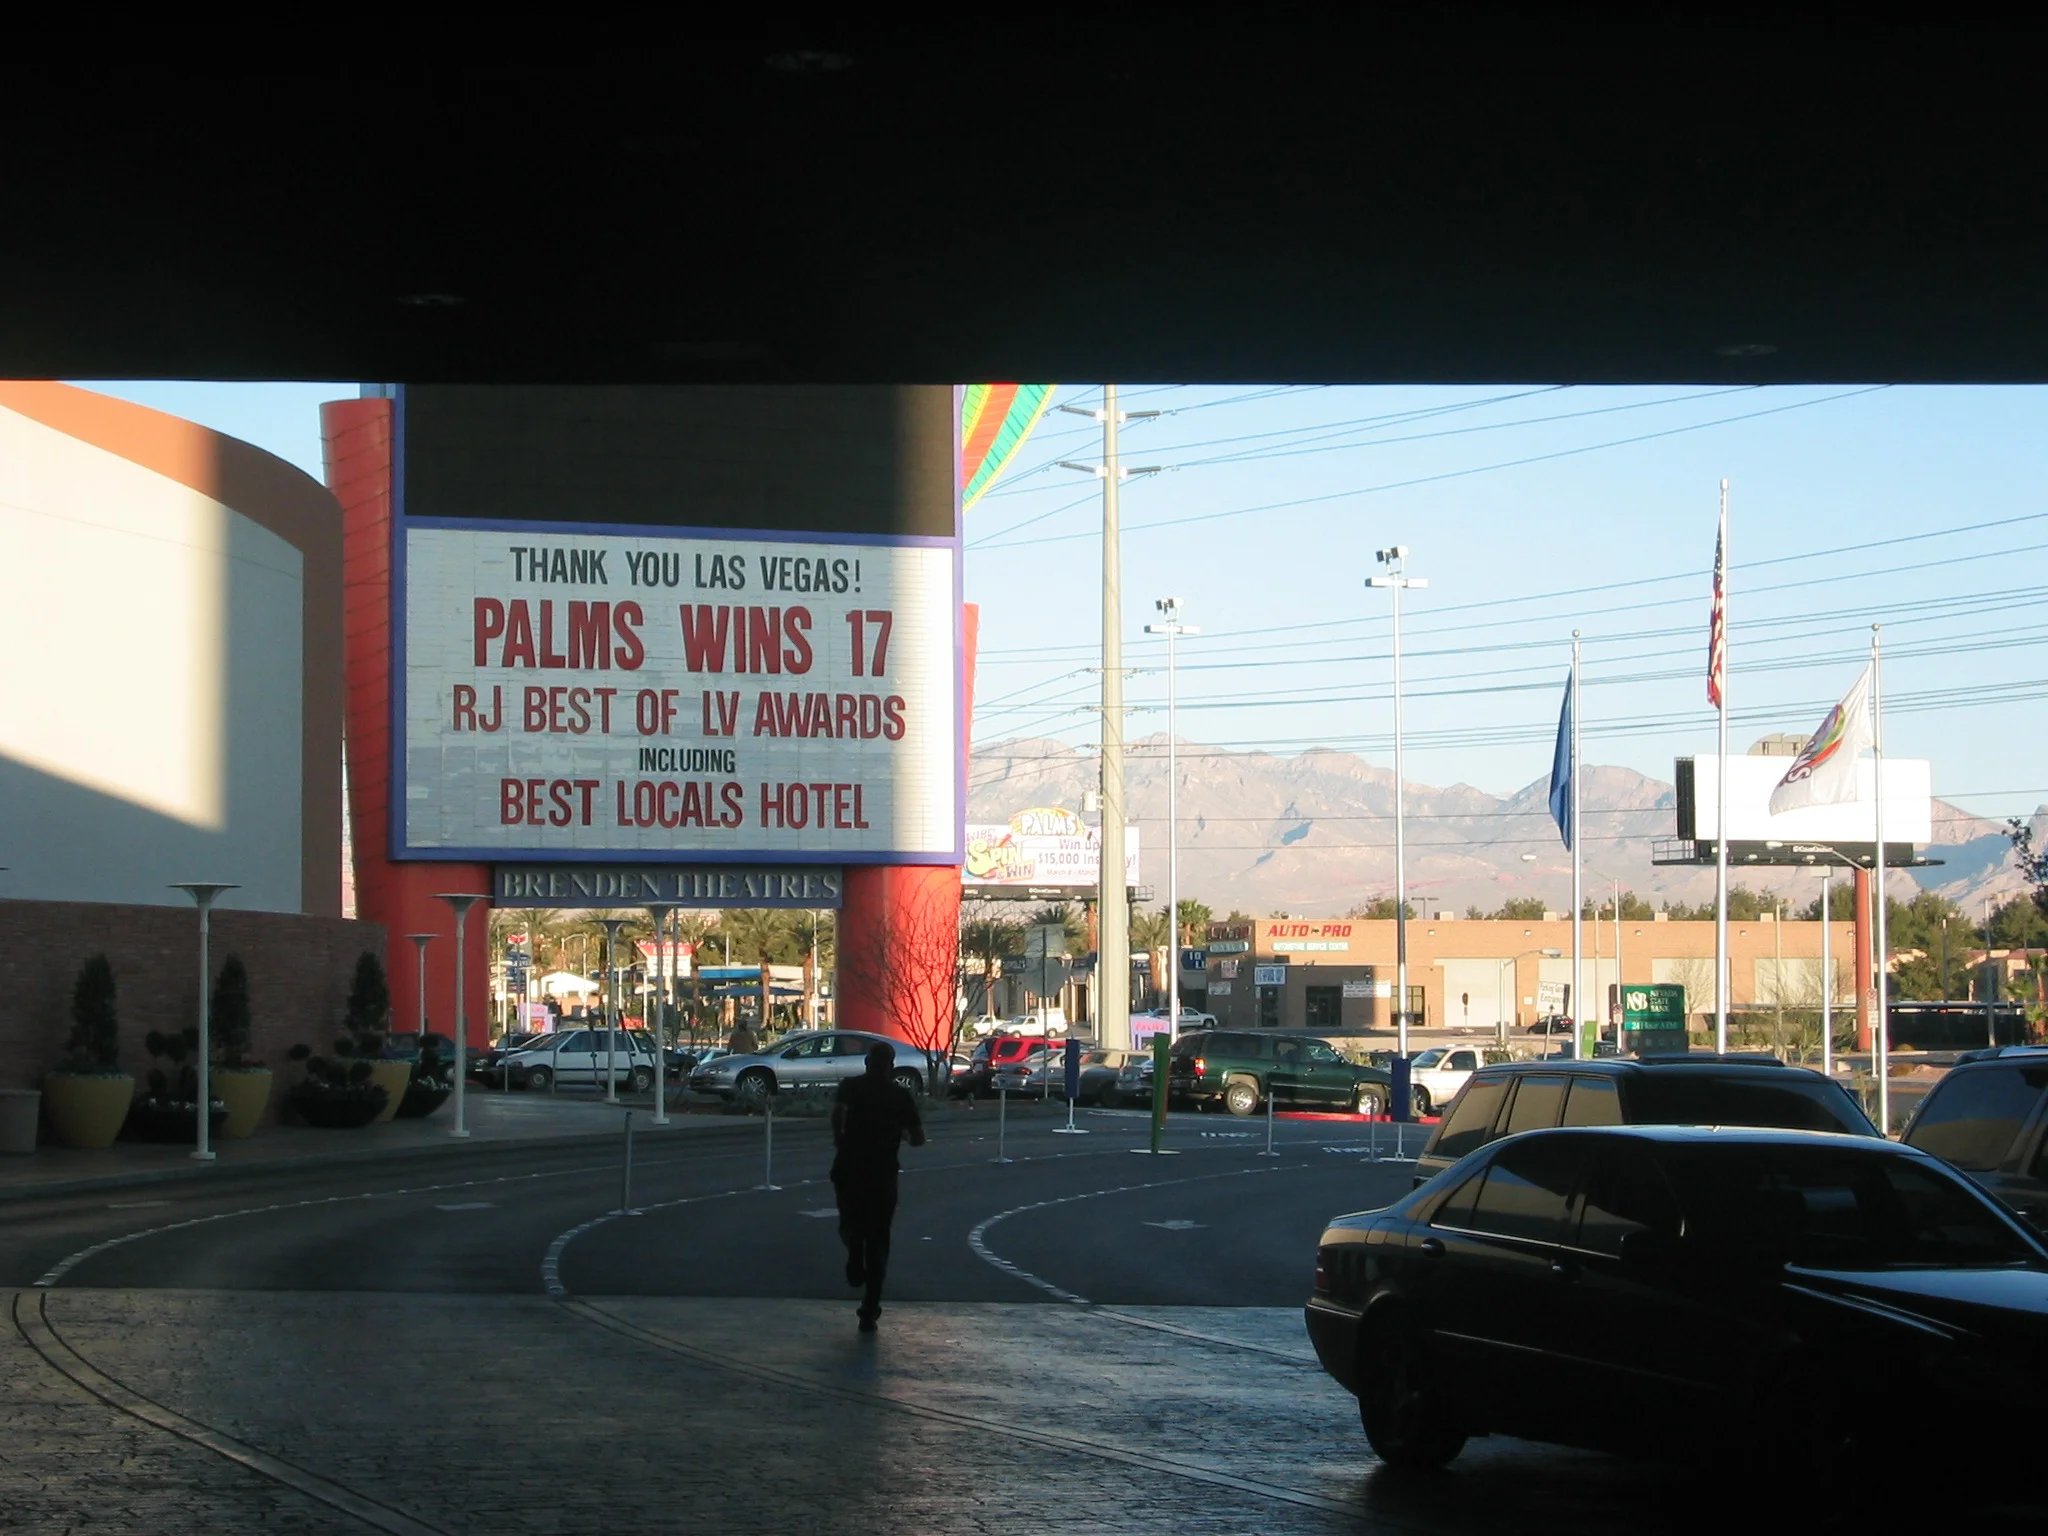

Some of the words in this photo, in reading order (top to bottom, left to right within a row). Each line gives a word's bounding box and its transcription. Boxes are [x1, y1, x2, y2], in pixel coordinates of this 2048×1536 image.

[509, 547, 608, 586] THANK
[625, 551, 679, 588] YOU
[695, 553, 746, 590] LAS
[760, 556, 862, 593] VEGAS!
[474, 597, 645, 671] PALMS
[680, 604, 812, 675] WINS
[846, 609, 893, 678] 17
[452, 683, 501, 733] RJ
[523, 685, 617, 735] BEST
[636, 688, 679, 736] OF
[702, 690, 740, 738] LV
[753, 691, 906, 741] AWARDS
[638, 747, 736, 774] INCLUDING
[500, 778, 599, 827] BEST
[616, 779, 744, 829] LOCALS
[760, 782, 869, 830] HOTEL
[1021, 811, 1077, 836] PALMS
[1059, 839, 1081, 850] Win
[1006, 862, 1033, 878] WIN
[1038, 852, 1079, 866] $15,000
[503, 868, 664, 899] BRENDEN
[673, 870, 841, 901] THEATRES
[1267, 924, 1309, 937] AUTO
[1321, 924, 1352, 937] PRO
[1650, 997, 1669, 1005] STATE
